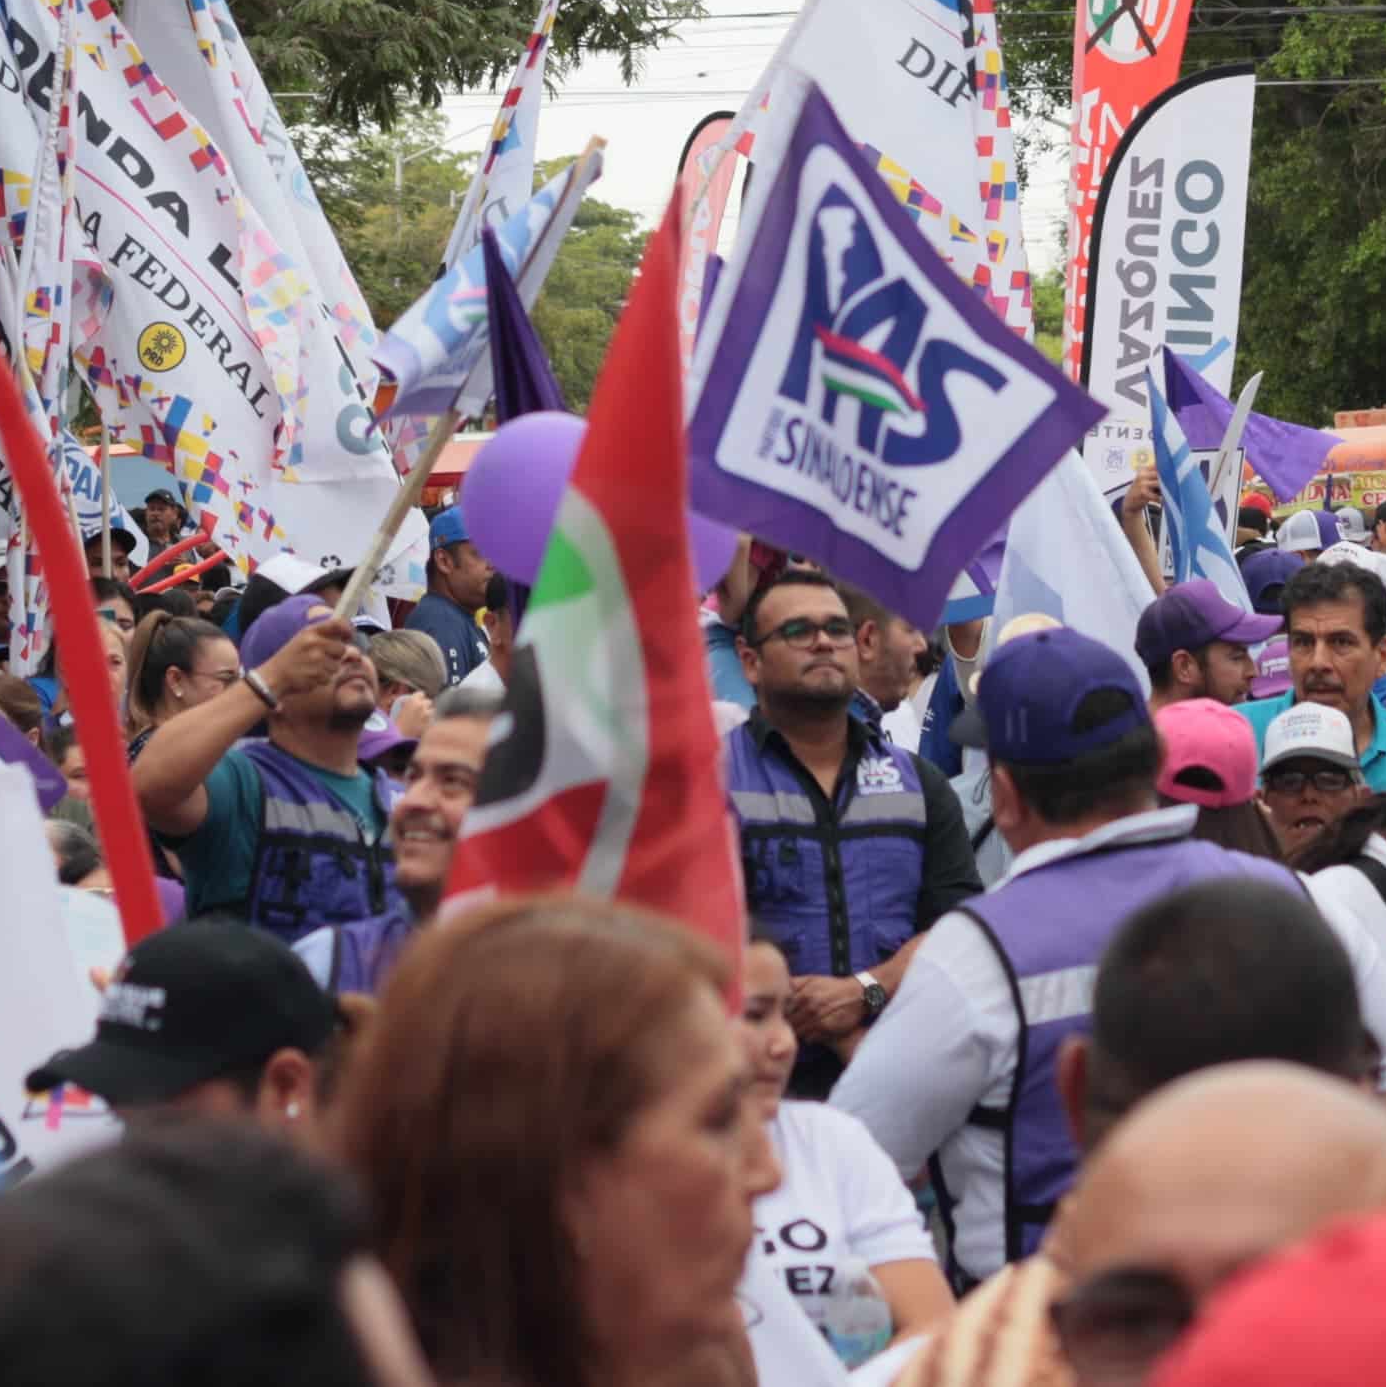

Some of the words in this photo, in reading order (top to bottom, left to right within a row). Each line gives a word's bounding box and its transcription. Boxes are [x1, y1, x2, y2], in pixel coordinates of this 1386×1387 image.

[109, 232, 273, 420] FEDERAL
[142, 345, 165, 366] PRD
[776, 417, 918, 539] SINALOENSE
